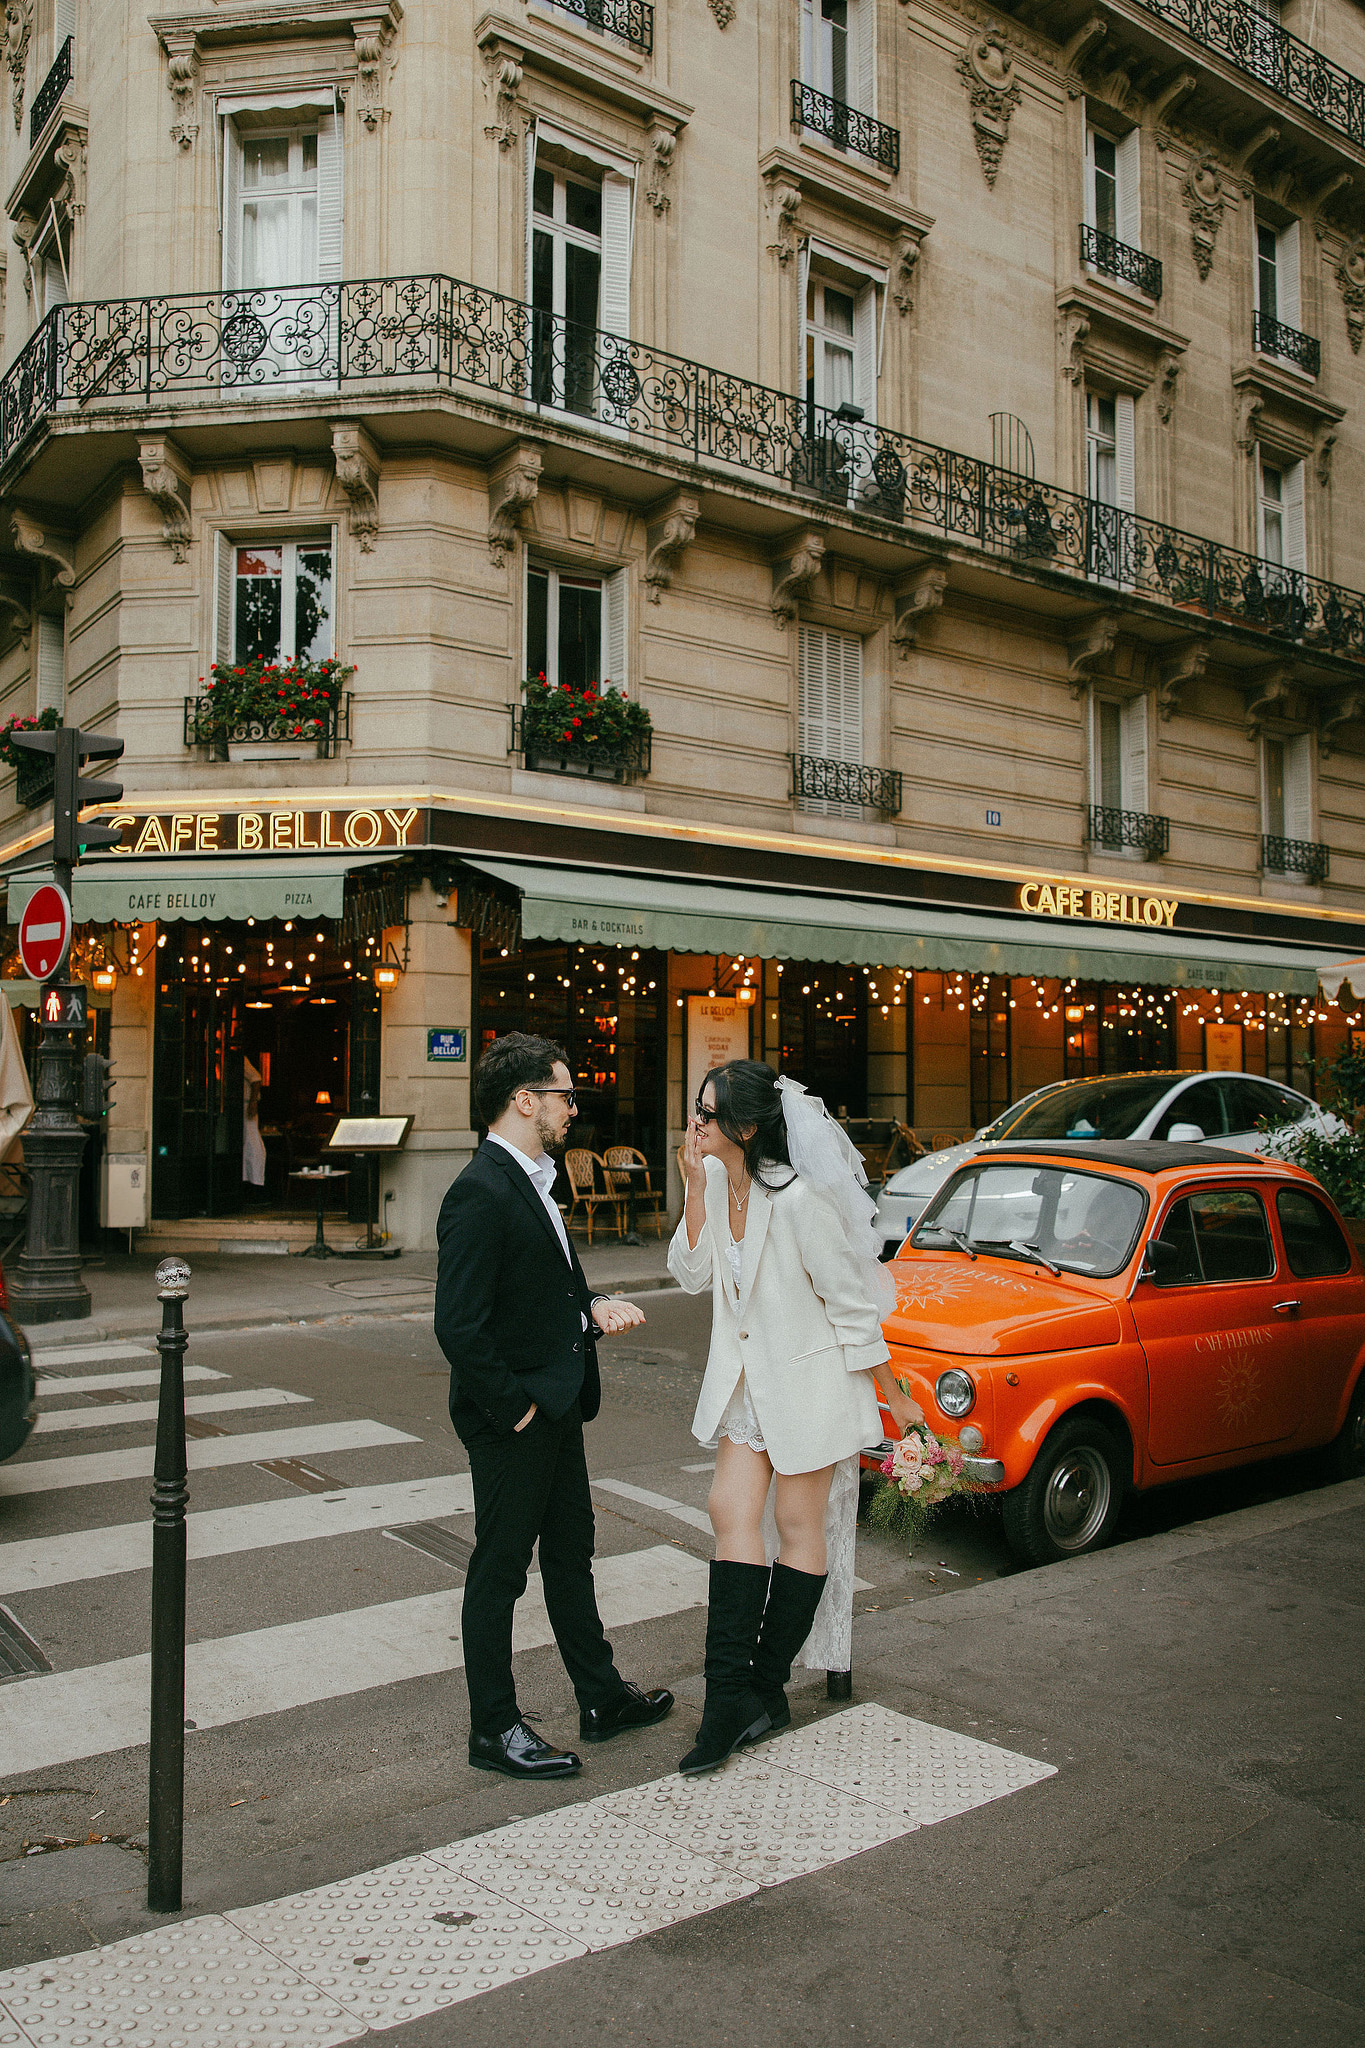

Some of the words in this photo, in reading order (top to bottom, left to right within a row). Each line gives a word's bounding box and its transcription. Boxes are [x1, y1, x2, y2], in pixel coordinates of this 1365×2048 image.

[988, 811, 999, 825] 10
[237, 807, 418, 851] BELLOY
[167, 892, 217, 909] BELLOY
[284, 893, 313, 905] PIZZA
[1020, 881, 1085, 918] CAFE
[1090, 889, 1179, 928] BELLOY
[572, 918, 588, 930] BAR
[592, 920, 597, 931] &
[600, 921, 644, 935] COCKTAILS
[710, 1006, 736, 1017] BELLOY
[440, 1034, 454, 1044] RUE
[433, 1046, 460, 1055] BELLOY
